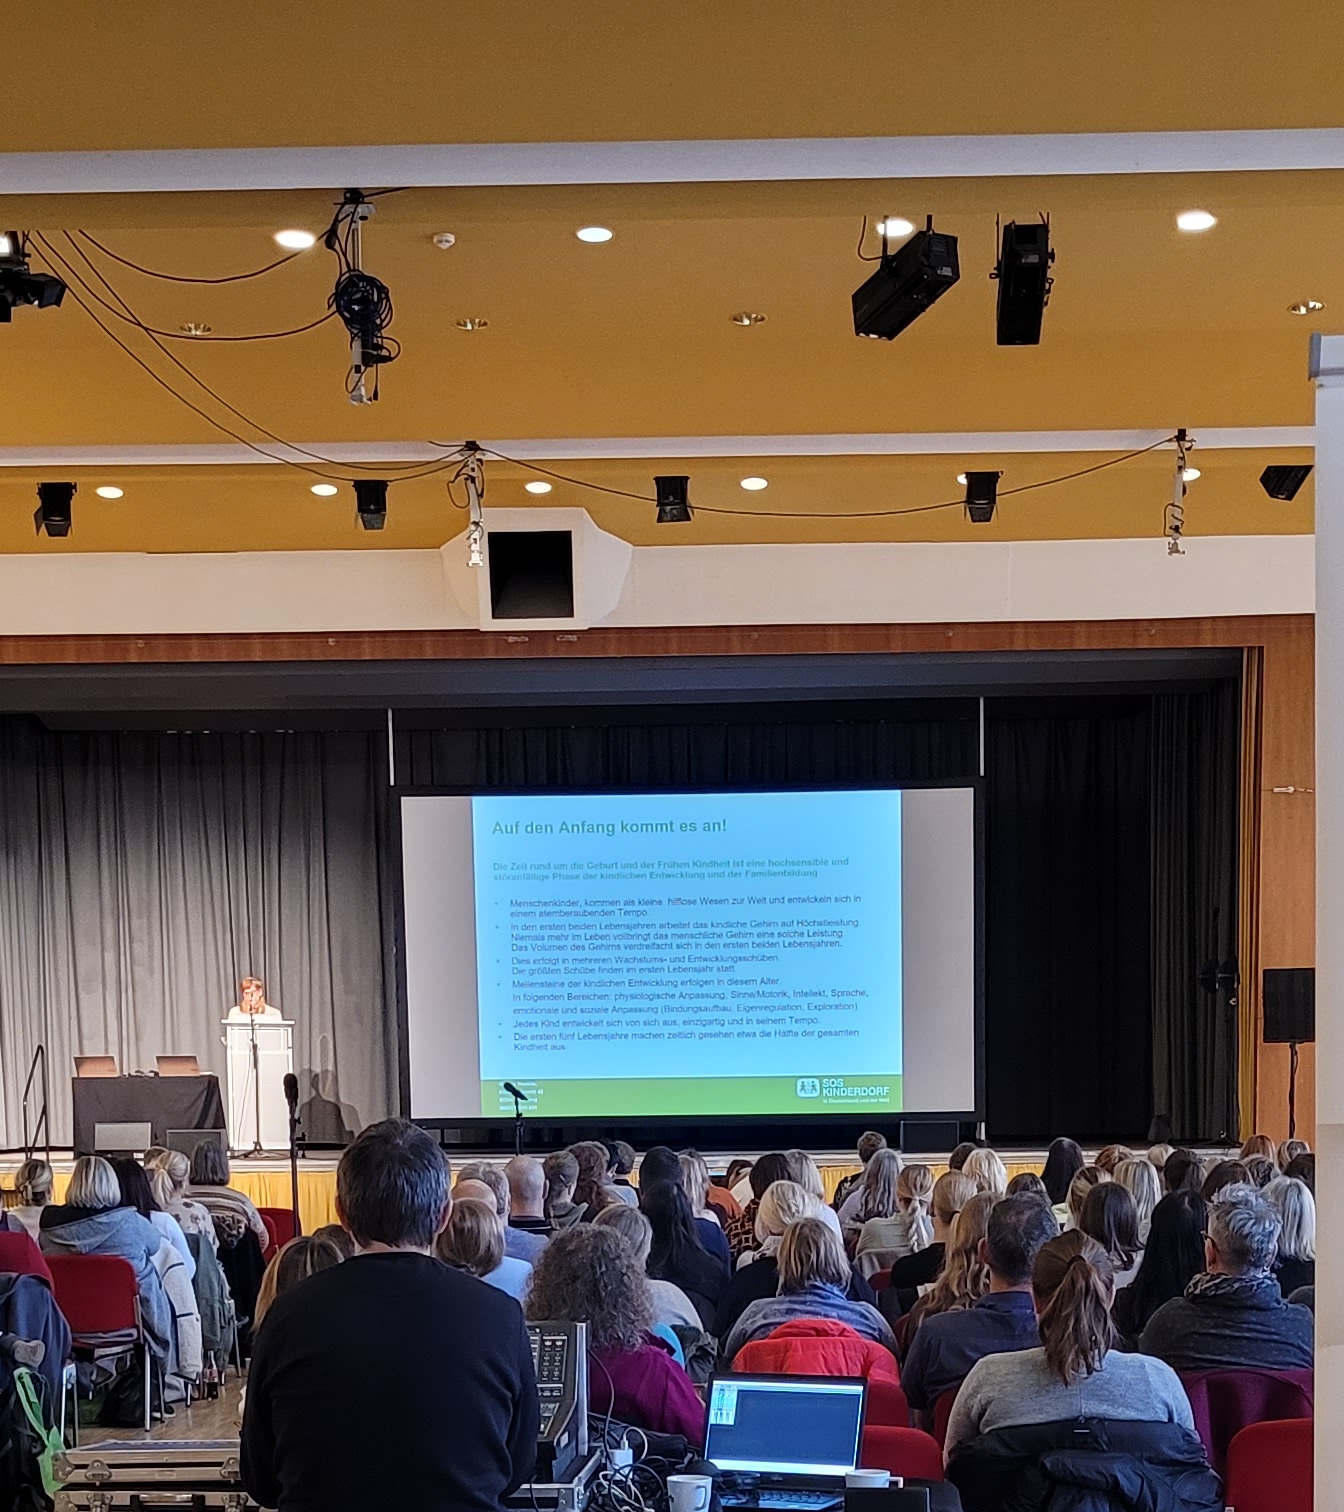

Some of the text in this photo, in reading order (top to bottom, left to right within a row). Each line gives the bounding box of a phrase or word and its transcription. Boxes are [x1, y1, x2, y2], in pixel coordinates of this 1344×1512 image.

[492, 818, 727, 838] Auf den Anfang kommt es an!
[493, 862, 507, 871] Die
[510, 862, 527, 871] Zeit
[530, 862, 551, 871] rund
[571, 862, 584, 870] die
[587, 861, 618, 870] Geburt
[621, 861, 637, 869] und
[640, 861, 655, 869] der
[657, 860, 689, 869] Frühen
[693, 860, 730, 869] Kindheit
[768, 859, 829, 868] hochsensible
[832, 858, 849, 867] und
[553, 871, 580, 880] Phase
[583, 871, 597, 880] der
[600, 870, 647, 879] kindlichen
[650, 870, 705, 881] Entwicklung
[708, 869, 725, 878] und
[728, 869, 742, 878] der
[745, 868, 817, 880] Familienbildung
[700, 896, 729, 905] Wesen
[769, 895, 784, 904] und
[787, 895, 832, 904] entwickeln
[521, 922, 537, 931] den
[512, 943, 528, 951] Das
[530, 942, 568, 951] Volumen
[670, 954, 686, 963] und
[728, 1017, 743, 1025] und
[822, 1078, 844, 1088] SOS
[822, 1086, 890, 1097] KINDERDORF
